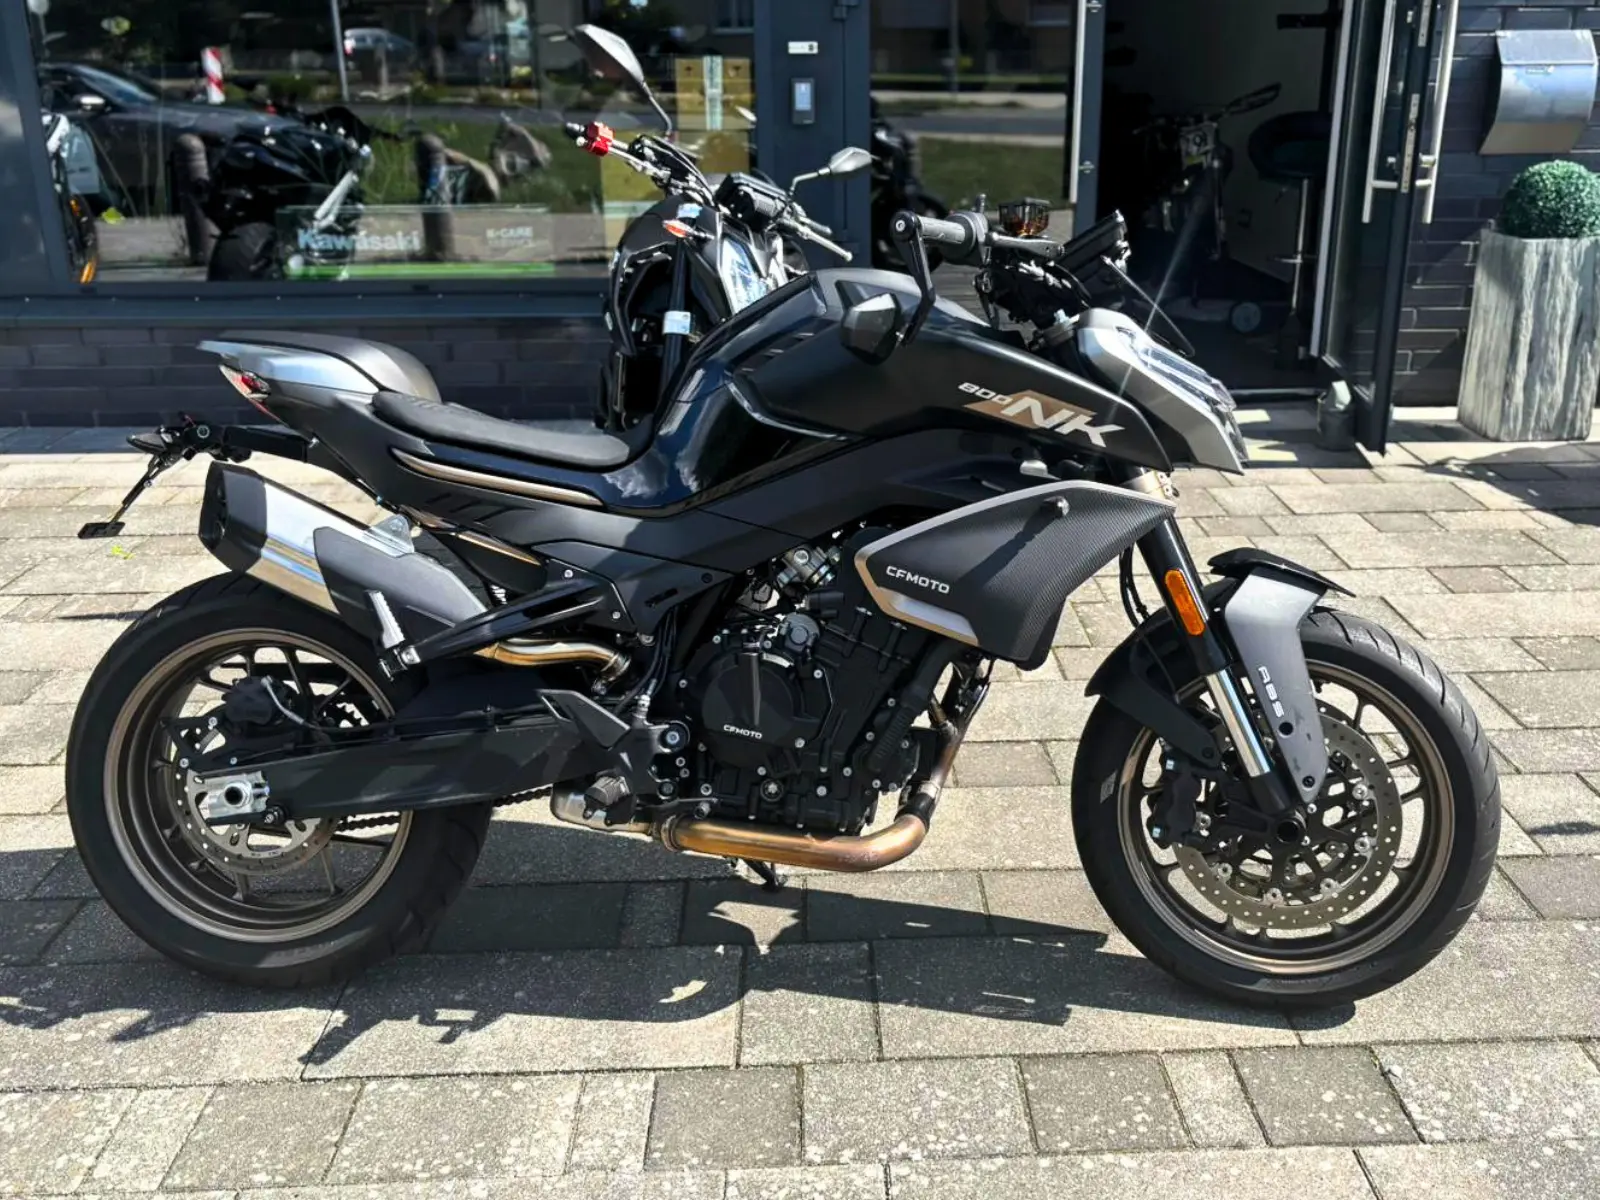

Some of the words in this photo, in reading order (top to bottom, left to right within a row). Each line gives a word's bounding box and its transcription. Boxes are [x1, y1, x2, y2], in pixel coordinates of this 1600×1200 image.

[297, 229, 421, 251] Kawasaki
[958, 382, 1014, 406] 800
[1000, 396, 1126, 448] NK
[885, 565, 950, 594] CFMOTO
[1258, 665, 1285, 718] ABS
[723, 724, 763, 740] CFMOTO
